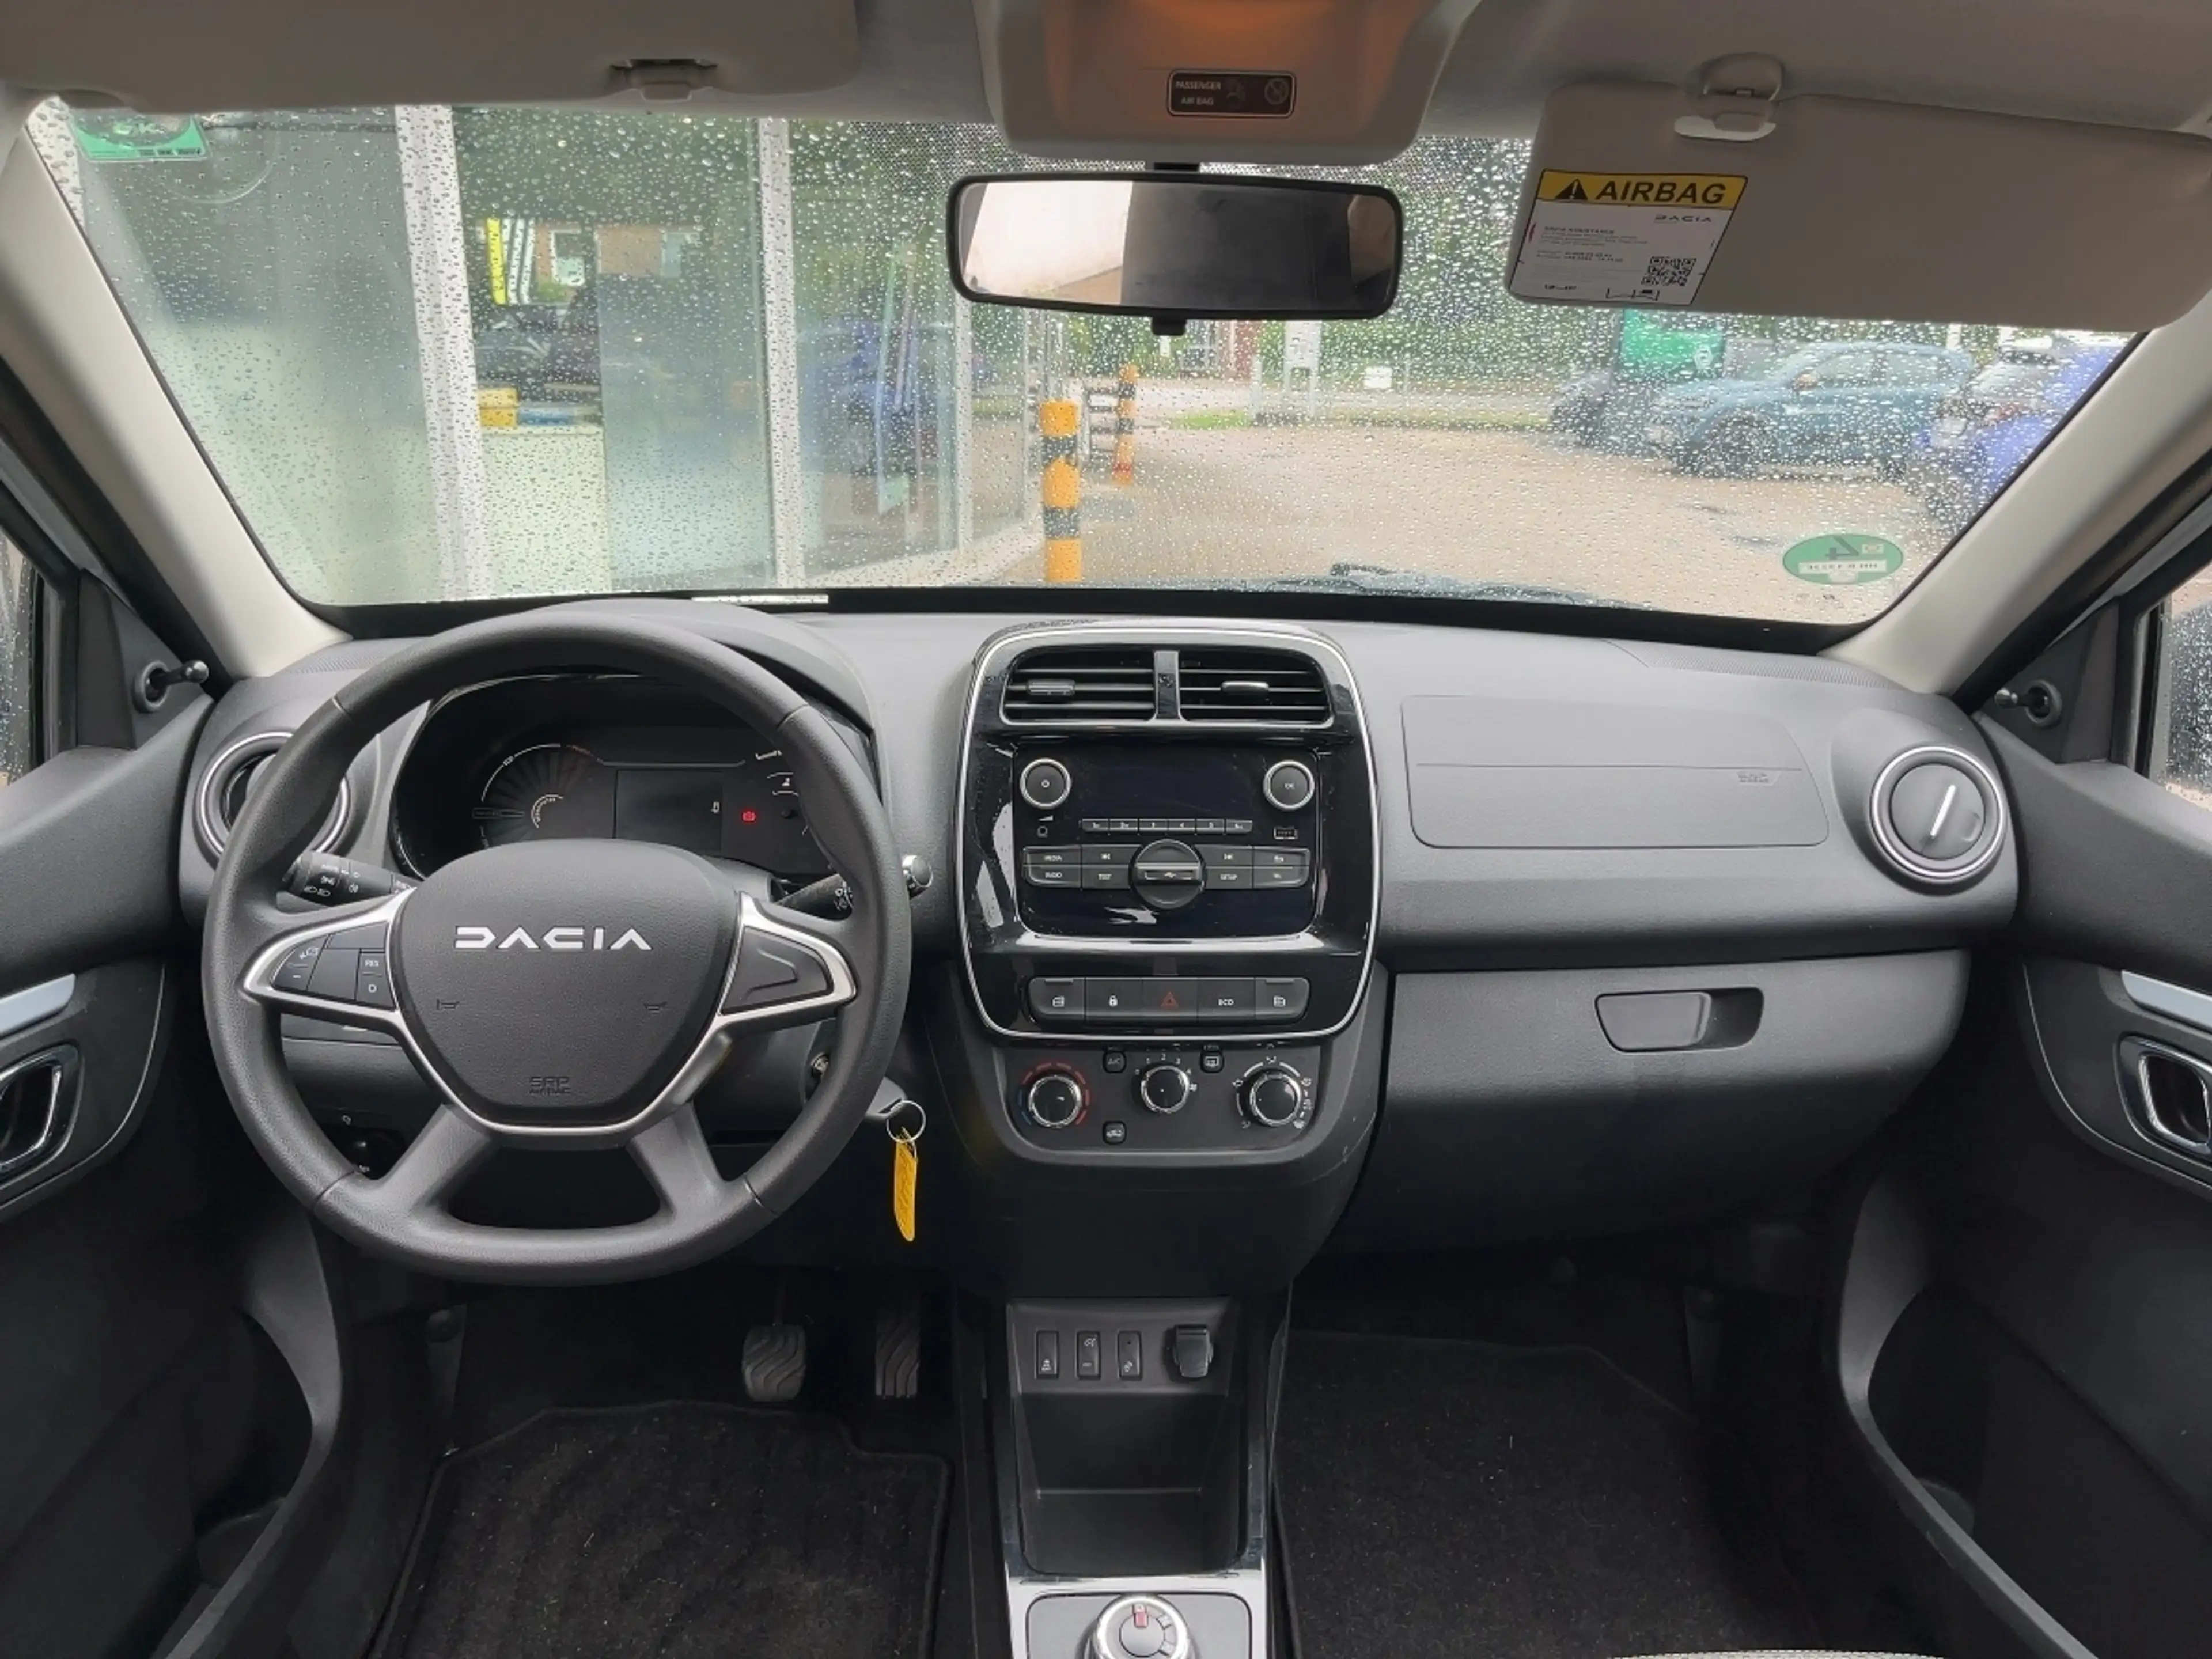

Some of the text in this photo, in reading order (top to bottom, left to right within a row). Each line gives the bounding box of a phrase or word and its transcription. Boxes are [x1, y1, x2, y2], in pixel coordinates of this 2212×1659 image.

[1175, 80, 1222, 90] PASSENGER
[1180, 96, 1214, 106] AIR BAG
[1596, 180, 1726, 204] AIRBAG
[454, 926, 652, 950] DACIA
